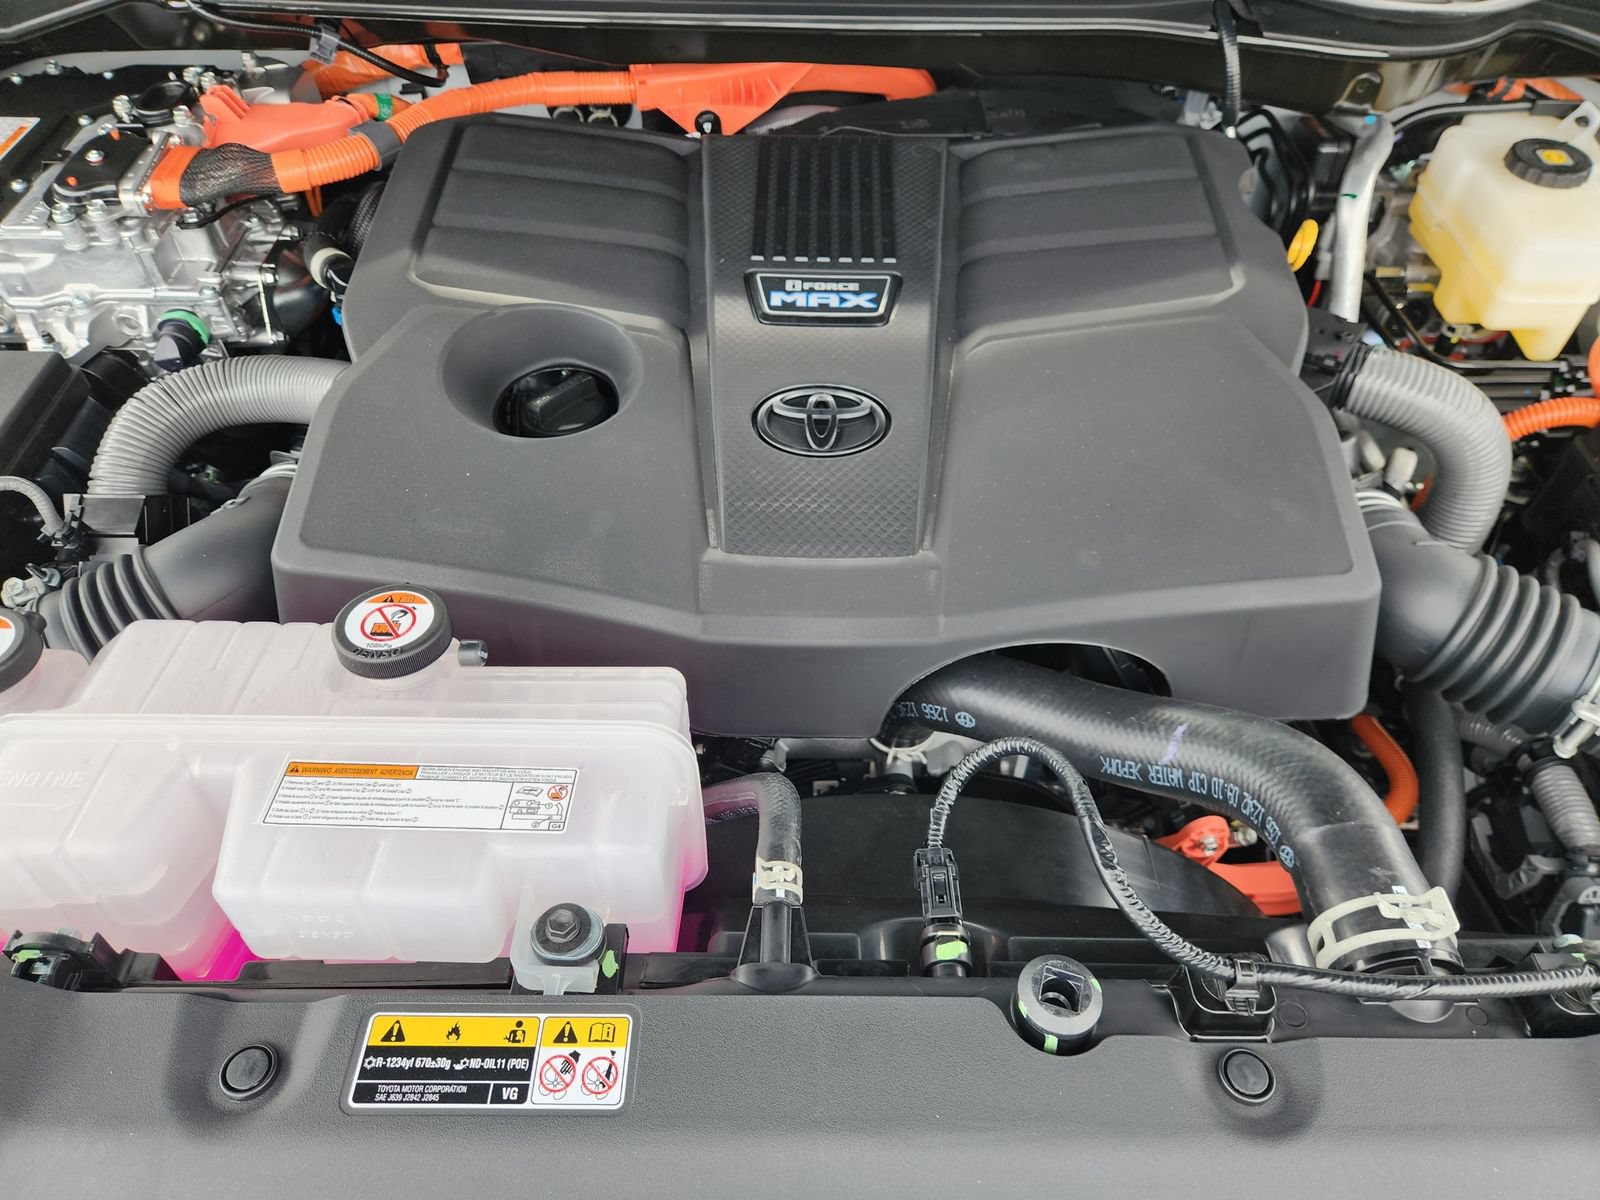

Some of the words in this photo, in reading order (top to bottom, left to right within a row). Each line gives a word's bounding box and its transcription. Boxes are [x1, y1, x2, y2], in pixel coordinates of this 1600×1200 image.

[770, 291, 878, 309] MAX
[302, 767, 332, 775] WARNING
[335, 768, 378, 776] AVERTISSEMENT
[1148, 764, 1185, 789] WATER
[376, 1056, 415, 1070] R-1234yf
[415, 1056, 452, 1071] 670±30g
[469, 1057, 506, 1069] ND-OIL11
[507, 1057, 530, 1072] (POE)
[377, 1084, 401, 1093] TOYOTA
[401, 1084, 424, 1093] MOTOR
[424, 1084, 468, 1094] CORPORATION
[502, 1087, 519, 1100] VG
[374, 1093, 388, 1101] SAE
